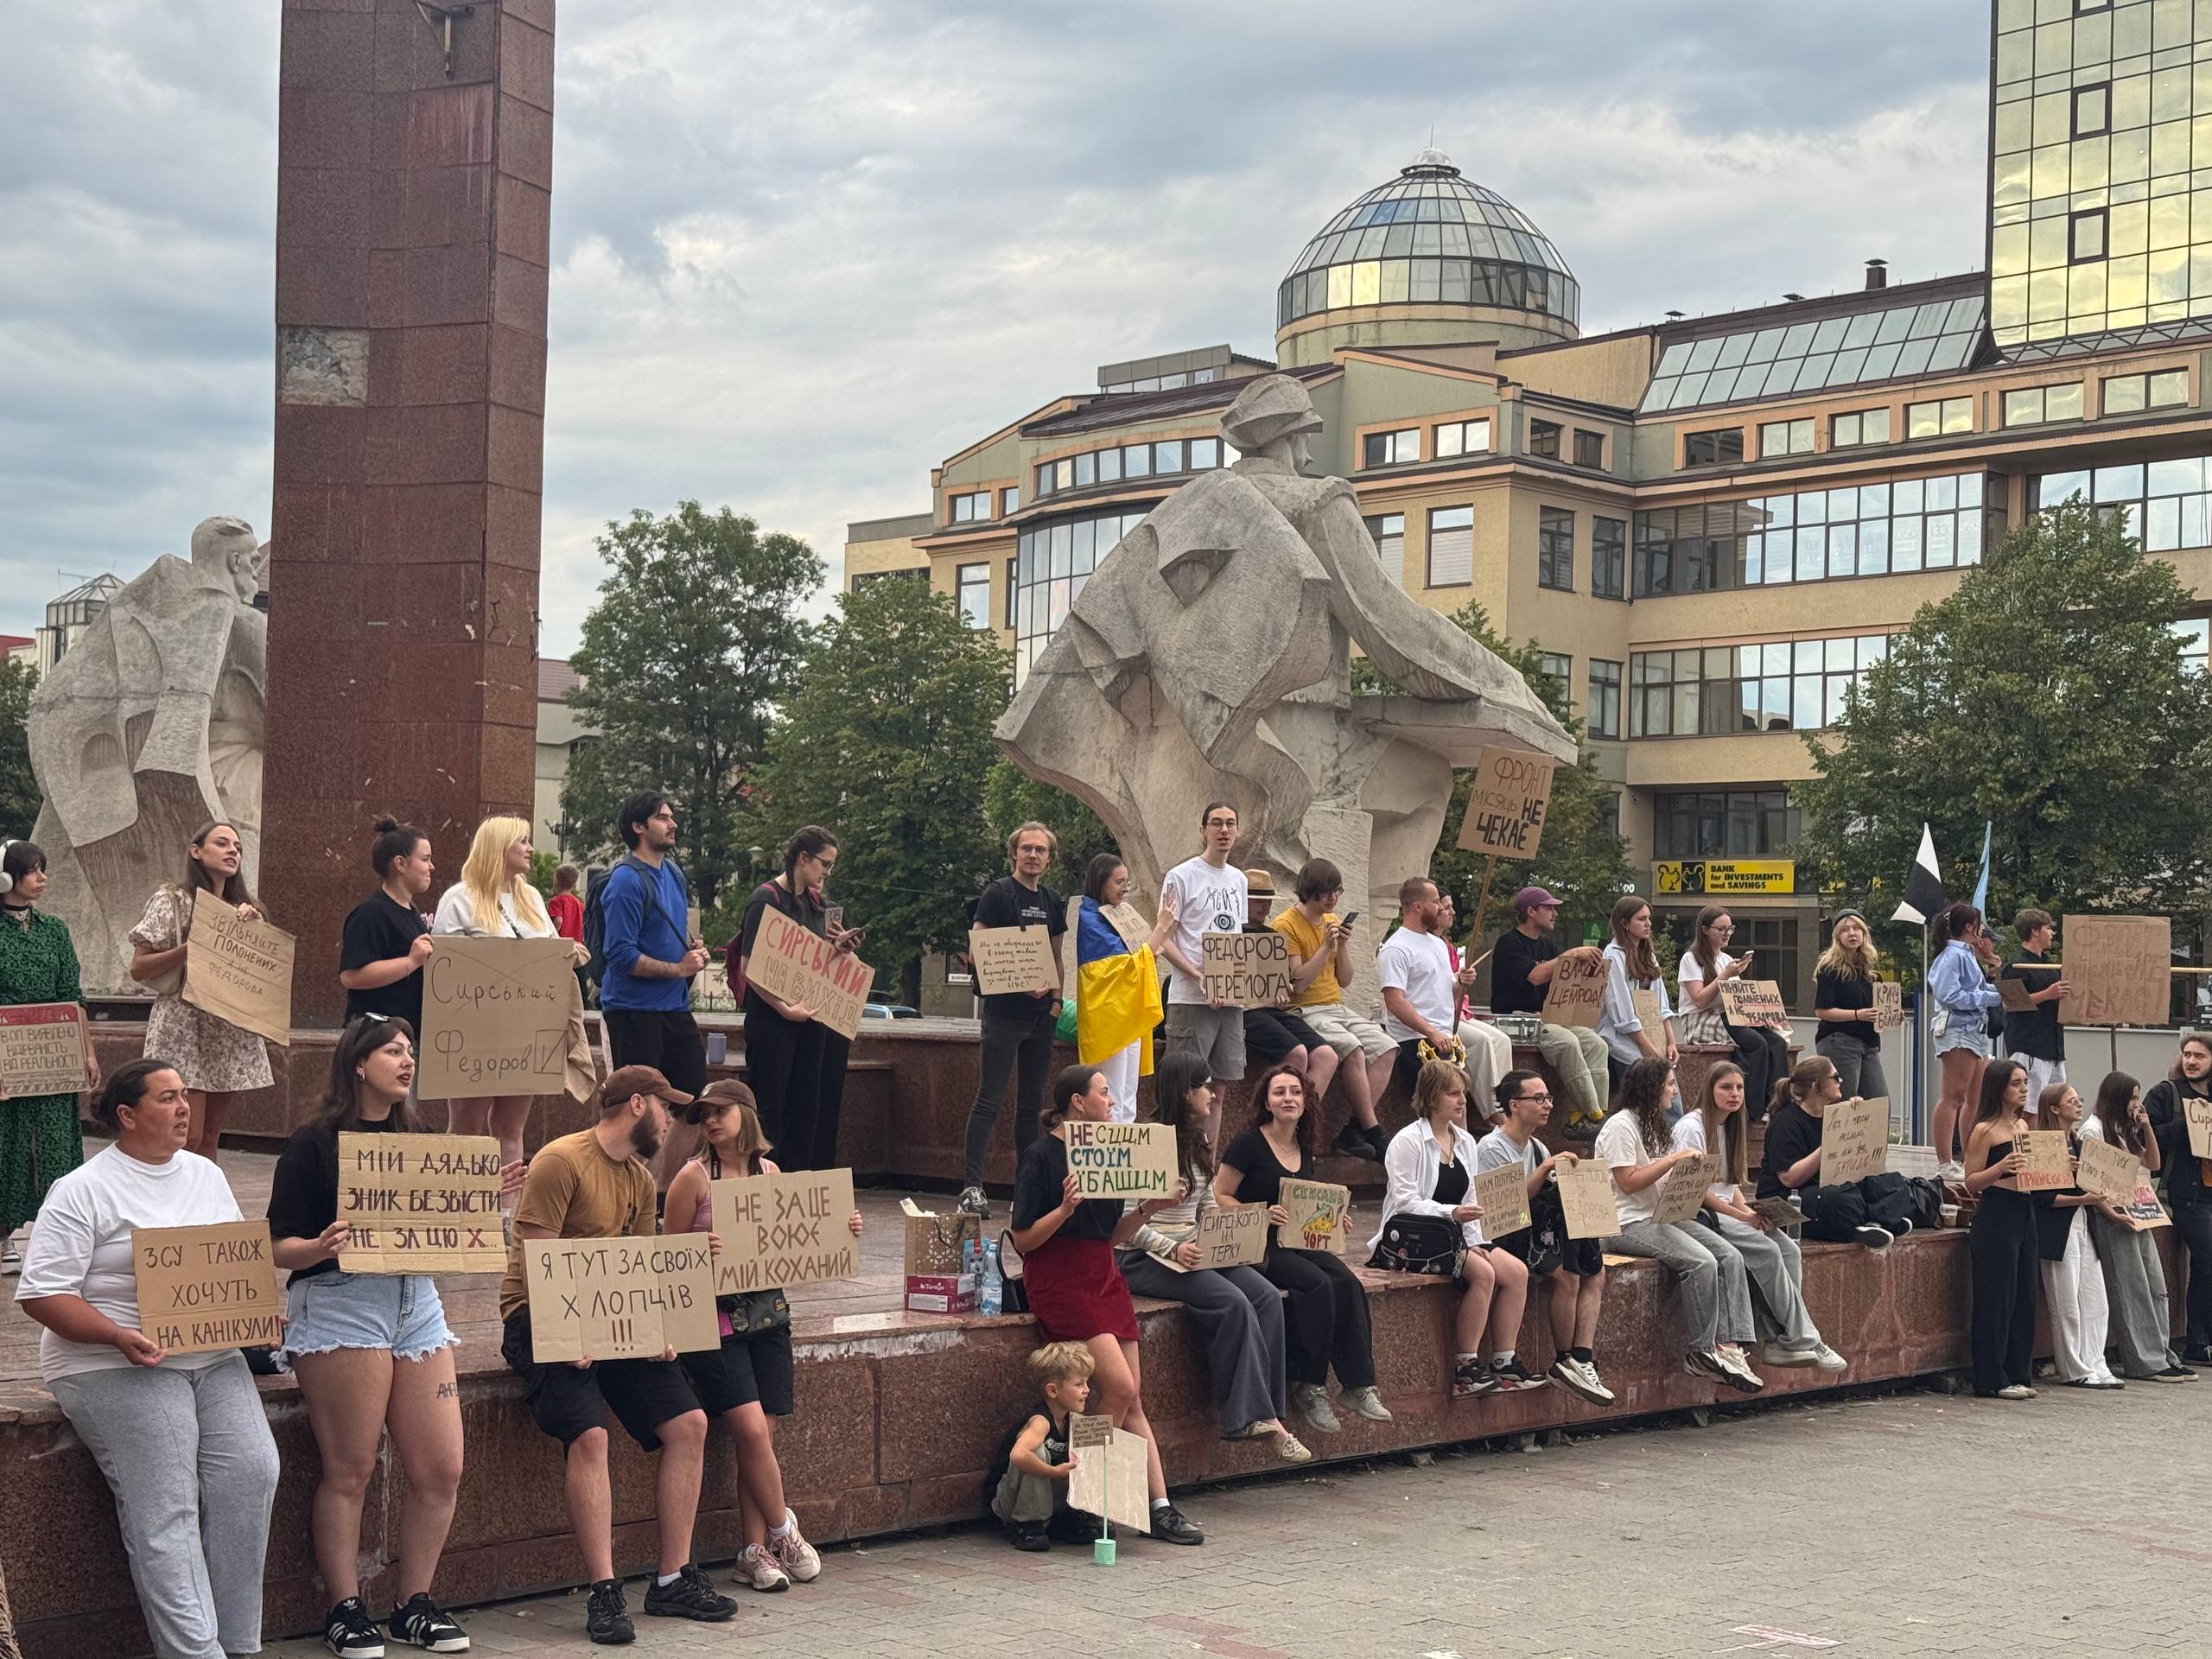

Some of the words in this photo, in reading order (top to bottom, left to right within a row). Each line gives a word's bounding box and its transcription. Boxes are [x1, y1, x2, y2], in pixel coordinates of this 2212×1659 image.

[1495, 757, 1550, 796] ФРОНТ
[1476, 812, 1529, 851] ЧЕКАЄ
[1725, 873, 1783, 881] INVESTMENTS
[1728, 881, 1766, 890] SAVINGS
[213, 934, 278, 973] ПОЛОНЕНИХ
[766, 917, 868, 997] СИРСЬКИЙ
[1202, 936, 1288, 962] ФЕДОРОВ
[208, 961, 263, 995] ФЕДОРОВА
[431, 956, 557, 1010] Сирський
[1205, 972, 1291, 1000] ПЕРЕМОГА
[763, 956, 788, 993] НА
[791, 971, 860, 1034] ВИХІД
[435, 1029, 532, 1083] Федоров
[1070, 1123, 1093, 1147] НЕ
[358, 1146, 404, 1173] МІЙ
[420, 1153, 500, 1176] ДЯДЬКО
[1071, 1147, 1132, 1167] СТОЇМ
[344, 1187, 403, 1211] ЗНИК
[410, 1189, 501, 1213] БЕЗВІСТИ
[735, 1193, 762, 1223] НЕ
[774, 1188, 805, 1222] ЗА
[809, 1186, 831, 1221] ЦЕ
[1204, 1211, 1260, 1232] СИРСЬКОГО
[1221, 1229, 1234, 1243] НА
[144, 1245, 182, 1268] ЗСУ
[199, 1238, 264, 1264] ТАКОЖ
[353, 1228, 379, 1248] НЕ
[393, 1227, 420, 1249] ЗА
[426, 1227, 458, 1249] ЦЮ
[758, 1222, 820, 1255] ВОЮЄ
[1211, 1243, 1242, 1262] ТЕРКУ
[1303, 1230, 1332, 1249] ЧОРТ
[541, 1252, 553, 1280] Я
[562, 1249, 608, 1279] ТУТ
[618, 1249, 646, 1275] ЗА
[650, 1248, 709, 1274] СВОЇХ
[719, 1259, 759, 1291] МІЙ
[765, 1246, 851, 1285] КОХАНИЙ
[171, 1279, 257, 1307] ХОЧУТЬ
[156, 1325, 185, 1349] НА
[192, 1314, 282, 1345] КАНІКУЛИ!
